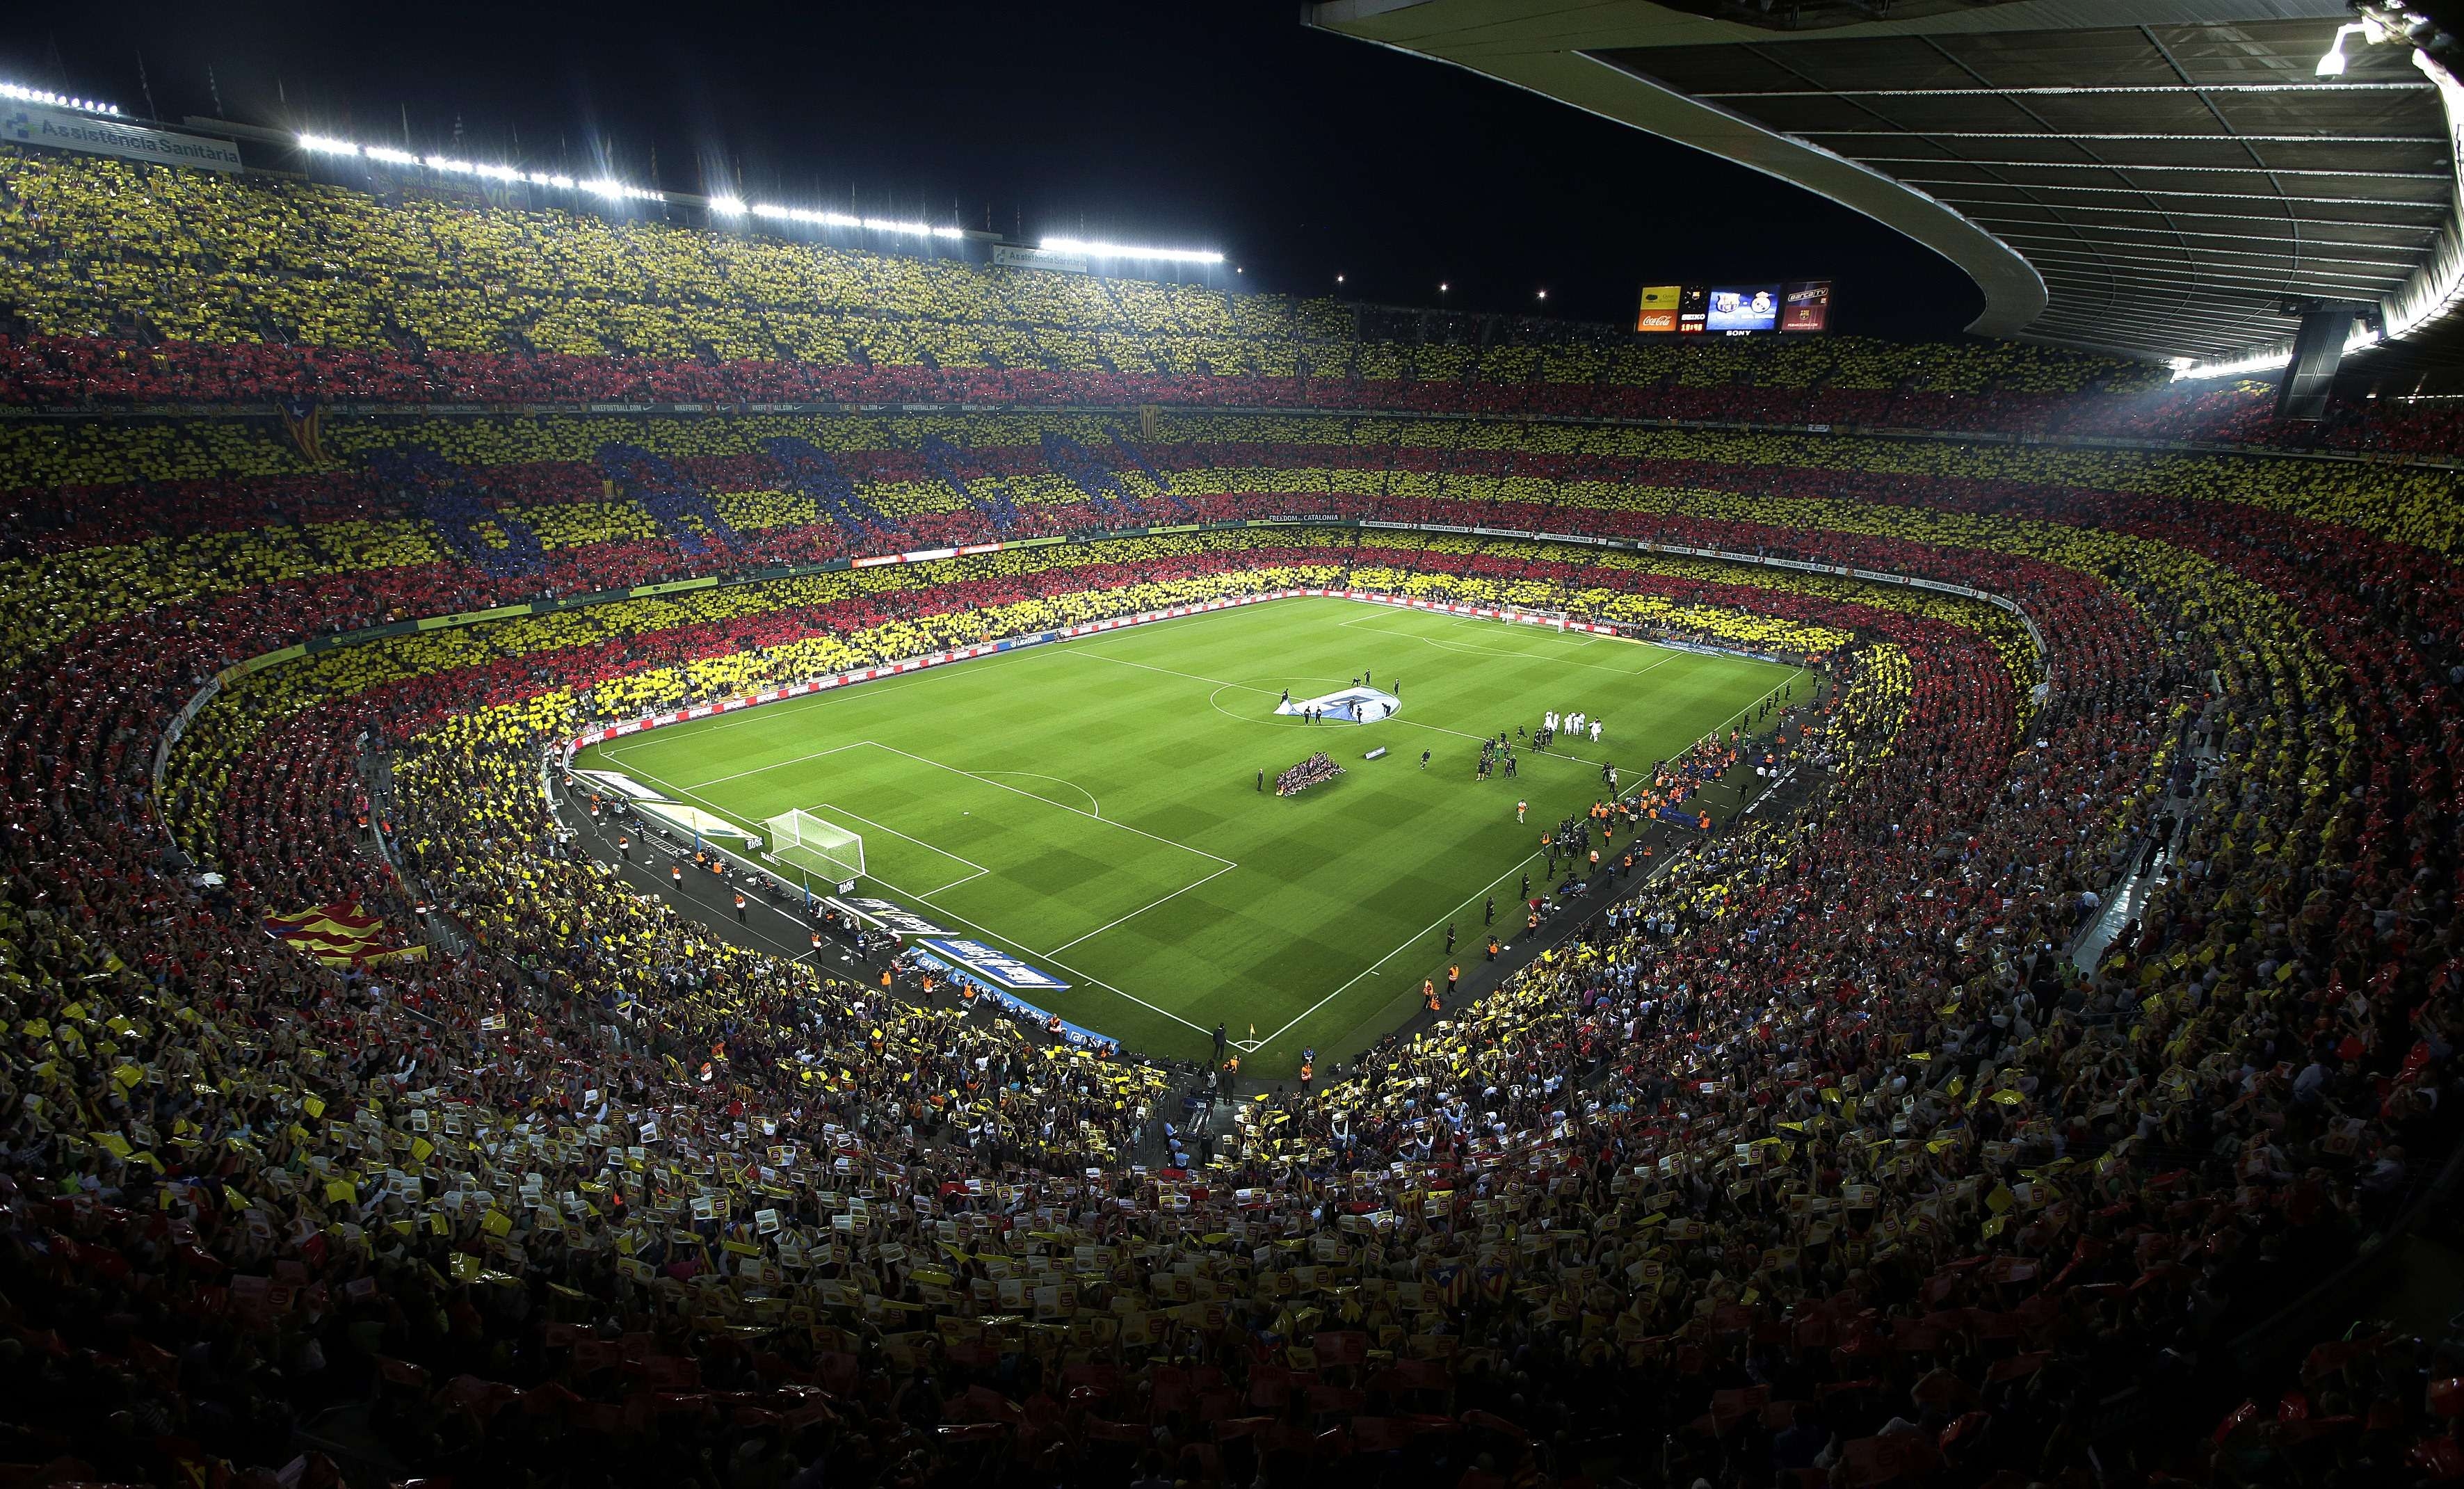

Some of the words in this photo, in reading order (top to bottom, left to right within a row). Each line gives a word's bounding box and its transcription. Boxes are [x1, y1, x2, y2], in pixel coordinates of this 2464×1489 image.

[159, 139, 239, 163] Sanitària
[1778, 560, 1801, 568] TURKISH
[1874, 574, 1900, 582] AIRLINES
[1924, 581, 1947, 590] TURKISH
[1948, 586, 1970, 595] AIRLINES
